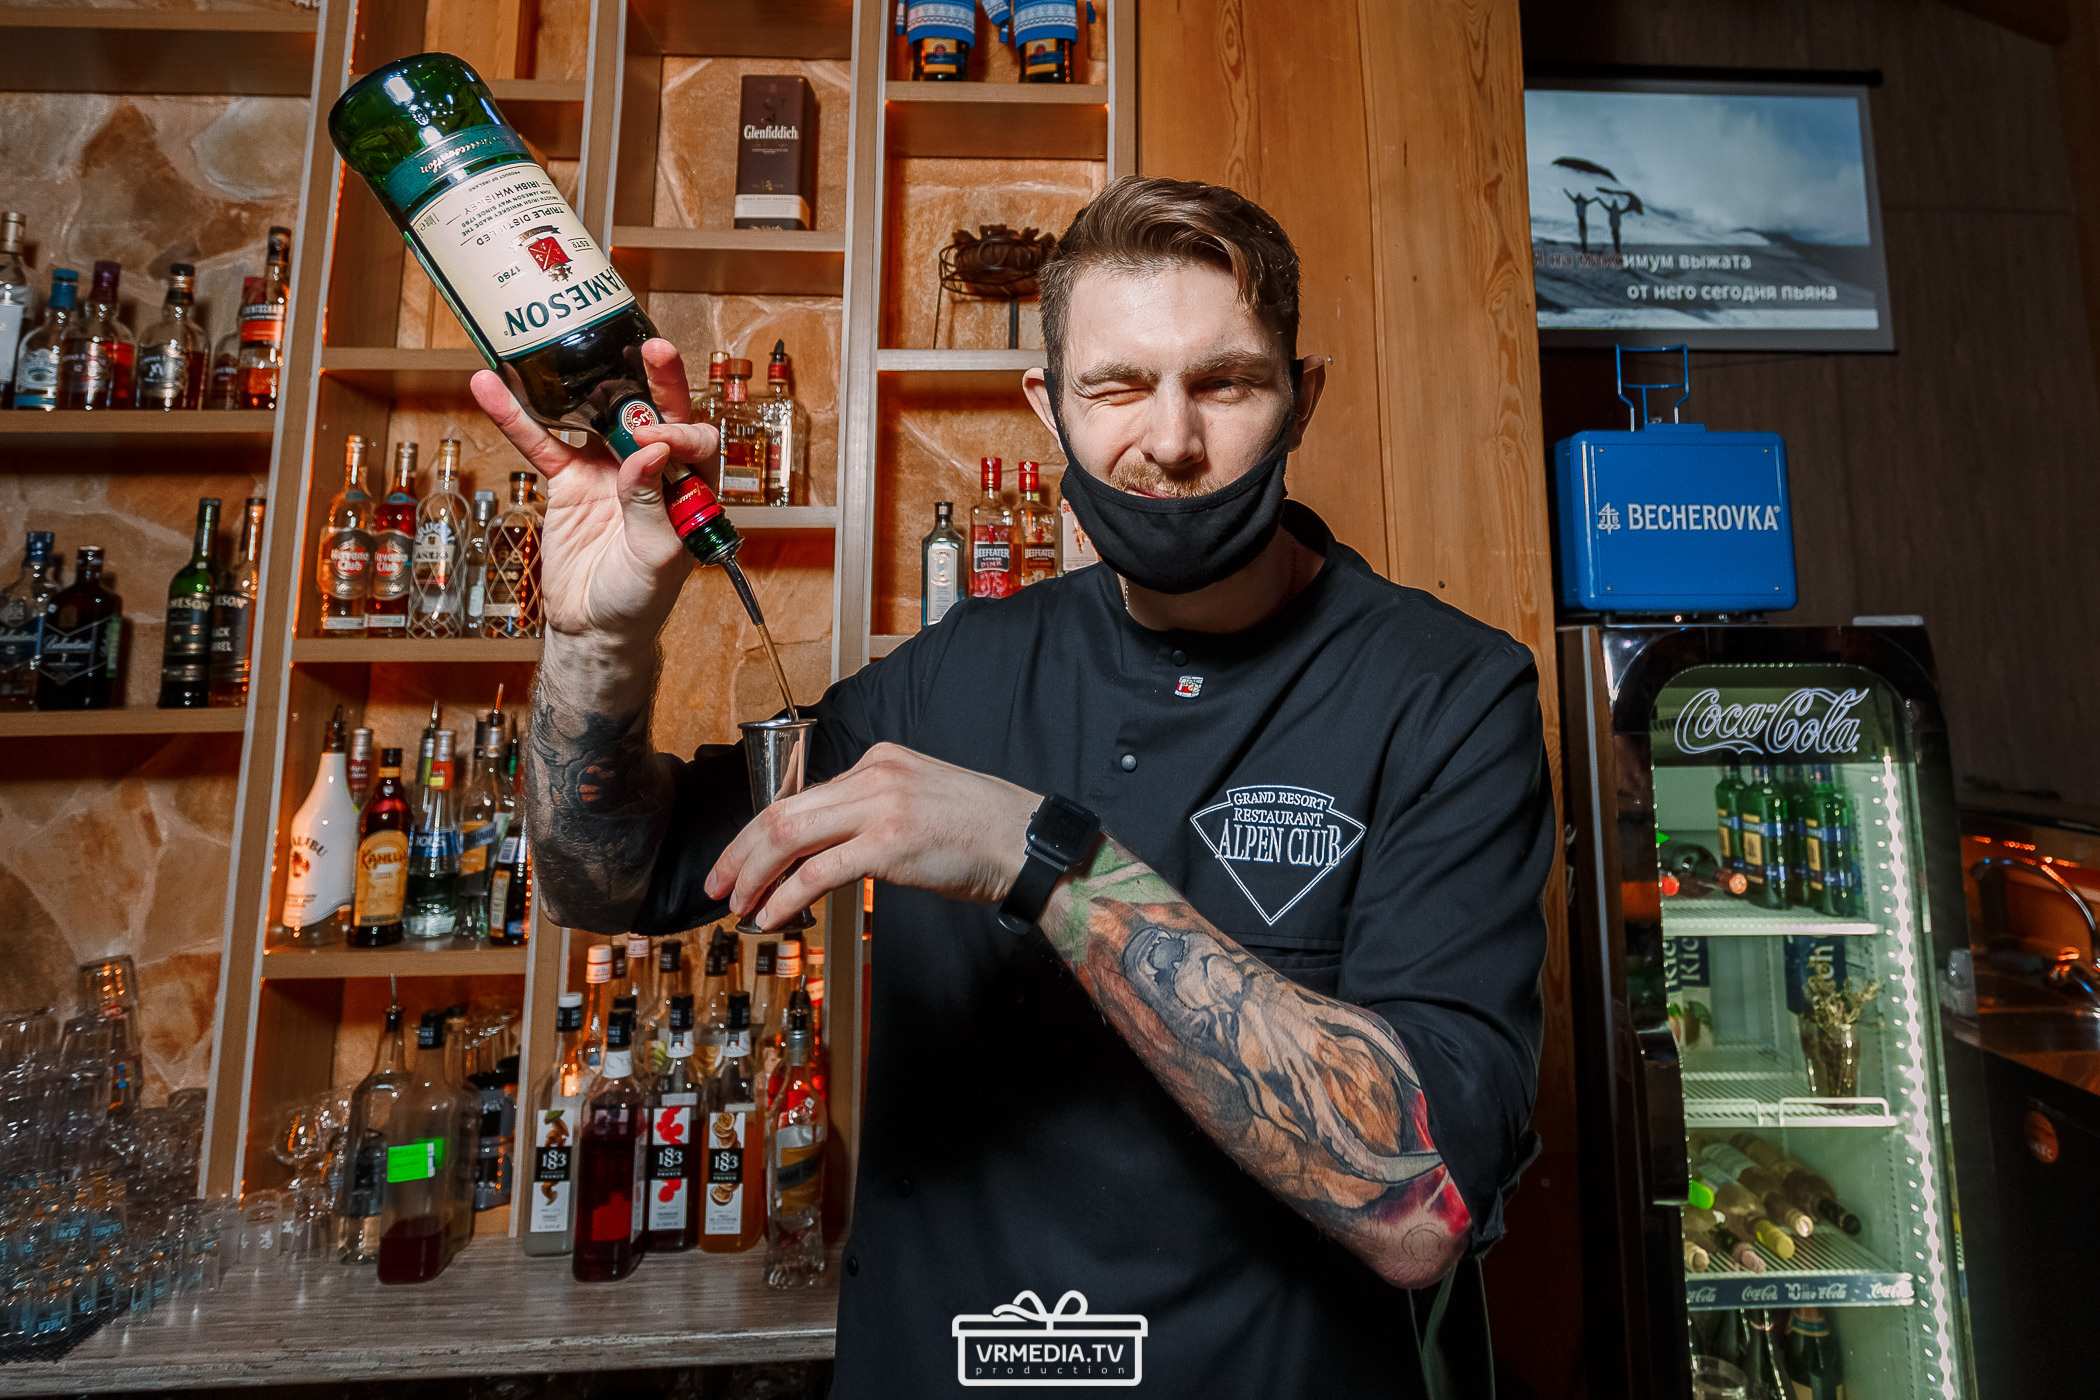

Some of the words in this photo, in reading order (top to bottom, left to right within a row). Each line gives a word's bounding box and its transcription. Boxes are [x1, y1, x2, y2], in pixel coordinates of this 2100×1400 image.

[743, 125, 799, 140] Glenfiddich
[513, 181, 541, 192] IRISH
[464, 187, 514, 215] WHISKEY
[497, 198, 512, 208] WAY
[512, 191, 540, 202] JAMESON
[523, 197, 540, 206] IRISH
[476, 205, 497, 219] SINCE
[493, 202, 523, 218] WHISKEY
[534, 206, 565, 220] TRIPLE
[475, 215, 493, 228] MADE
[475, 212, 533, 246] DISTILLED
[461, 226, 474, 237] THE
[1678, 253, 1751, 270] выжата
[497, 265, 521, 284] 1780
[504, 265, 626, 337] JAMESON
[1626, 285, 1649, 300] от
[1653, 285, 1697, 300] него
[1701, 285, 1778, 303] сегодня
[1781, 285, 1838, 301] пьяна
[1627, 503, 1779, 531] BECHEROVKA
[974, 548, 1010, 559] BEEFEATER
[1024, 548, 1055, 559] BEEFEATER
[980, 560, 1002, 568] PINK
[1674, 687, 1869, 756] Coca-Cola
[1233, 791, 1276, 806] GRAND
[1277, 792, 1328, 811] RESORT
[1232, 807, 1324, 827] RESTAURANT
[1215, 818, 1285, 863] ALPEN
[1287, 824, 1342, 867] CLUB
